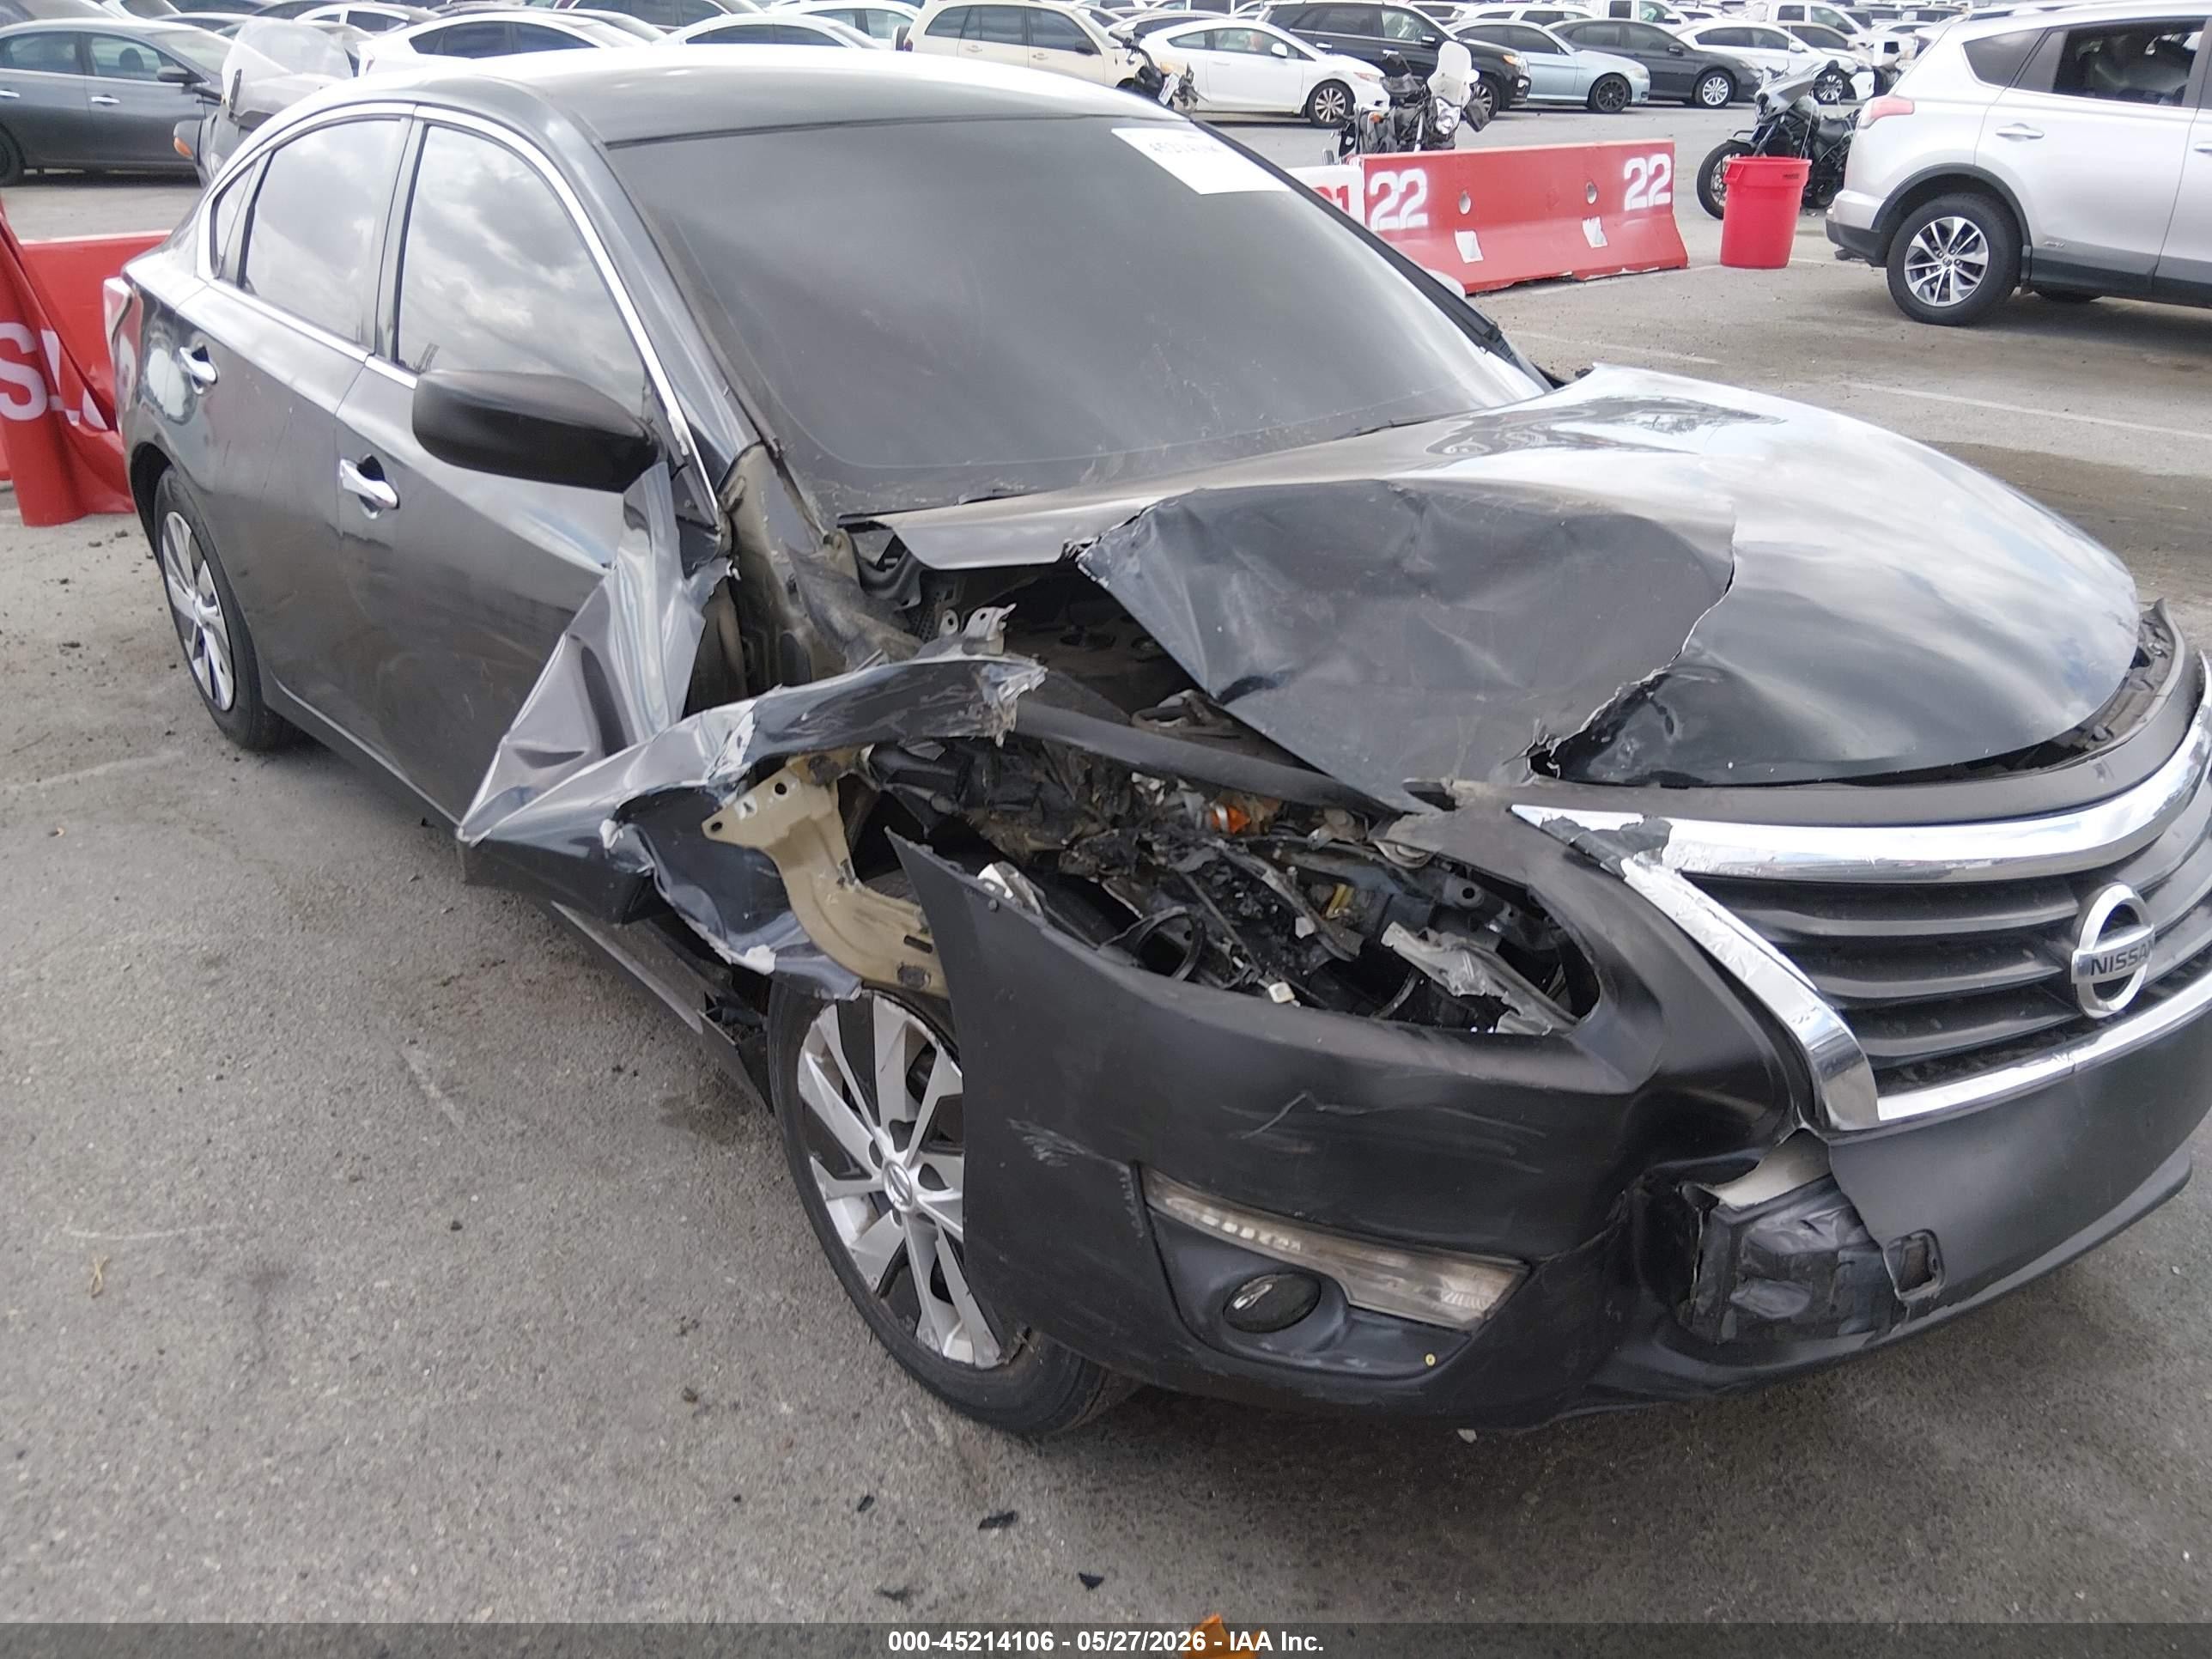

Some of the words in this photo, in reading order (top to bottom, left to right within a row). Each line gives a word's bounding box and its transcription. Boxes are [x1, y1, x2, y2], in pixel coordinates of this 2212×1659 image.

[1370, 168, 1429, 230] 22
[1623, 153, 1671, 211] 22
[2090, 939, 2156, 975] NISSAN
